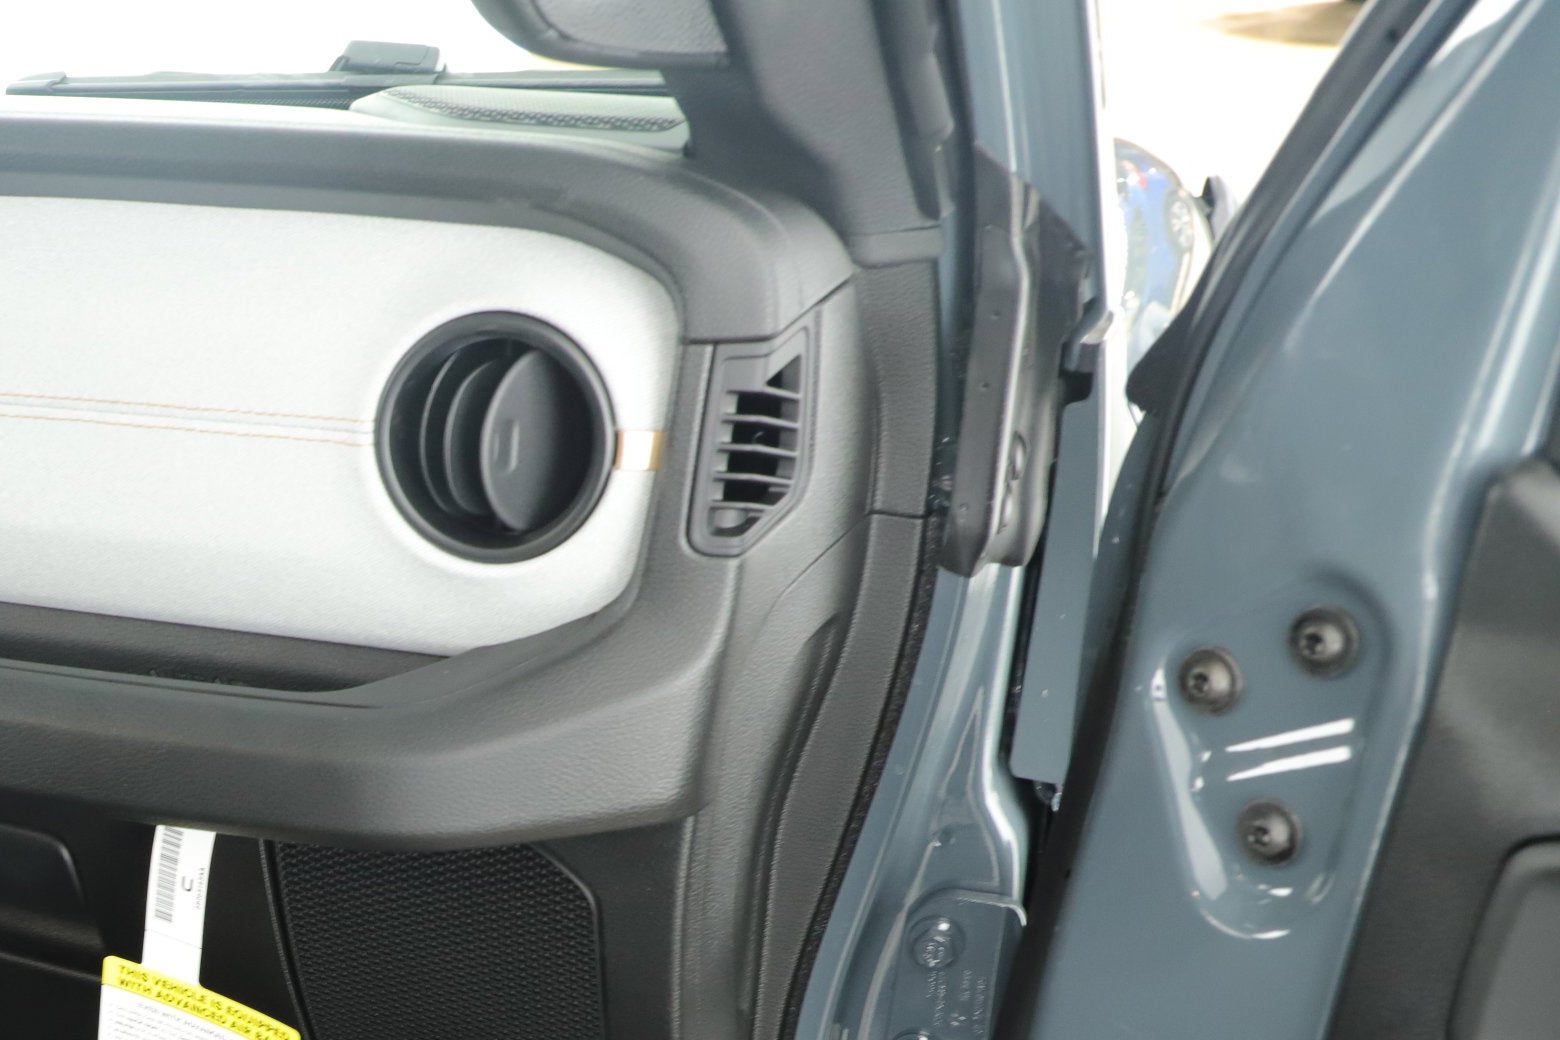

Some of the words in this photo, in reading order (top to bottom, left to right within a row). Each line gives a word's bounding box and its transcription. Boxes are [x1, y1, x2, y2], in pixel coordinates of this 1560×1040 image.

[118, 964, 148, 982] THIS
[153, 976, 208, 1003] VEHICLE
[210, 995, 223, 1011] IS
[119, 978, 152, 995] WITH
[155, 990, 227, 1025] ADVANCED
[229, 1019, 252, 1035] AIR
